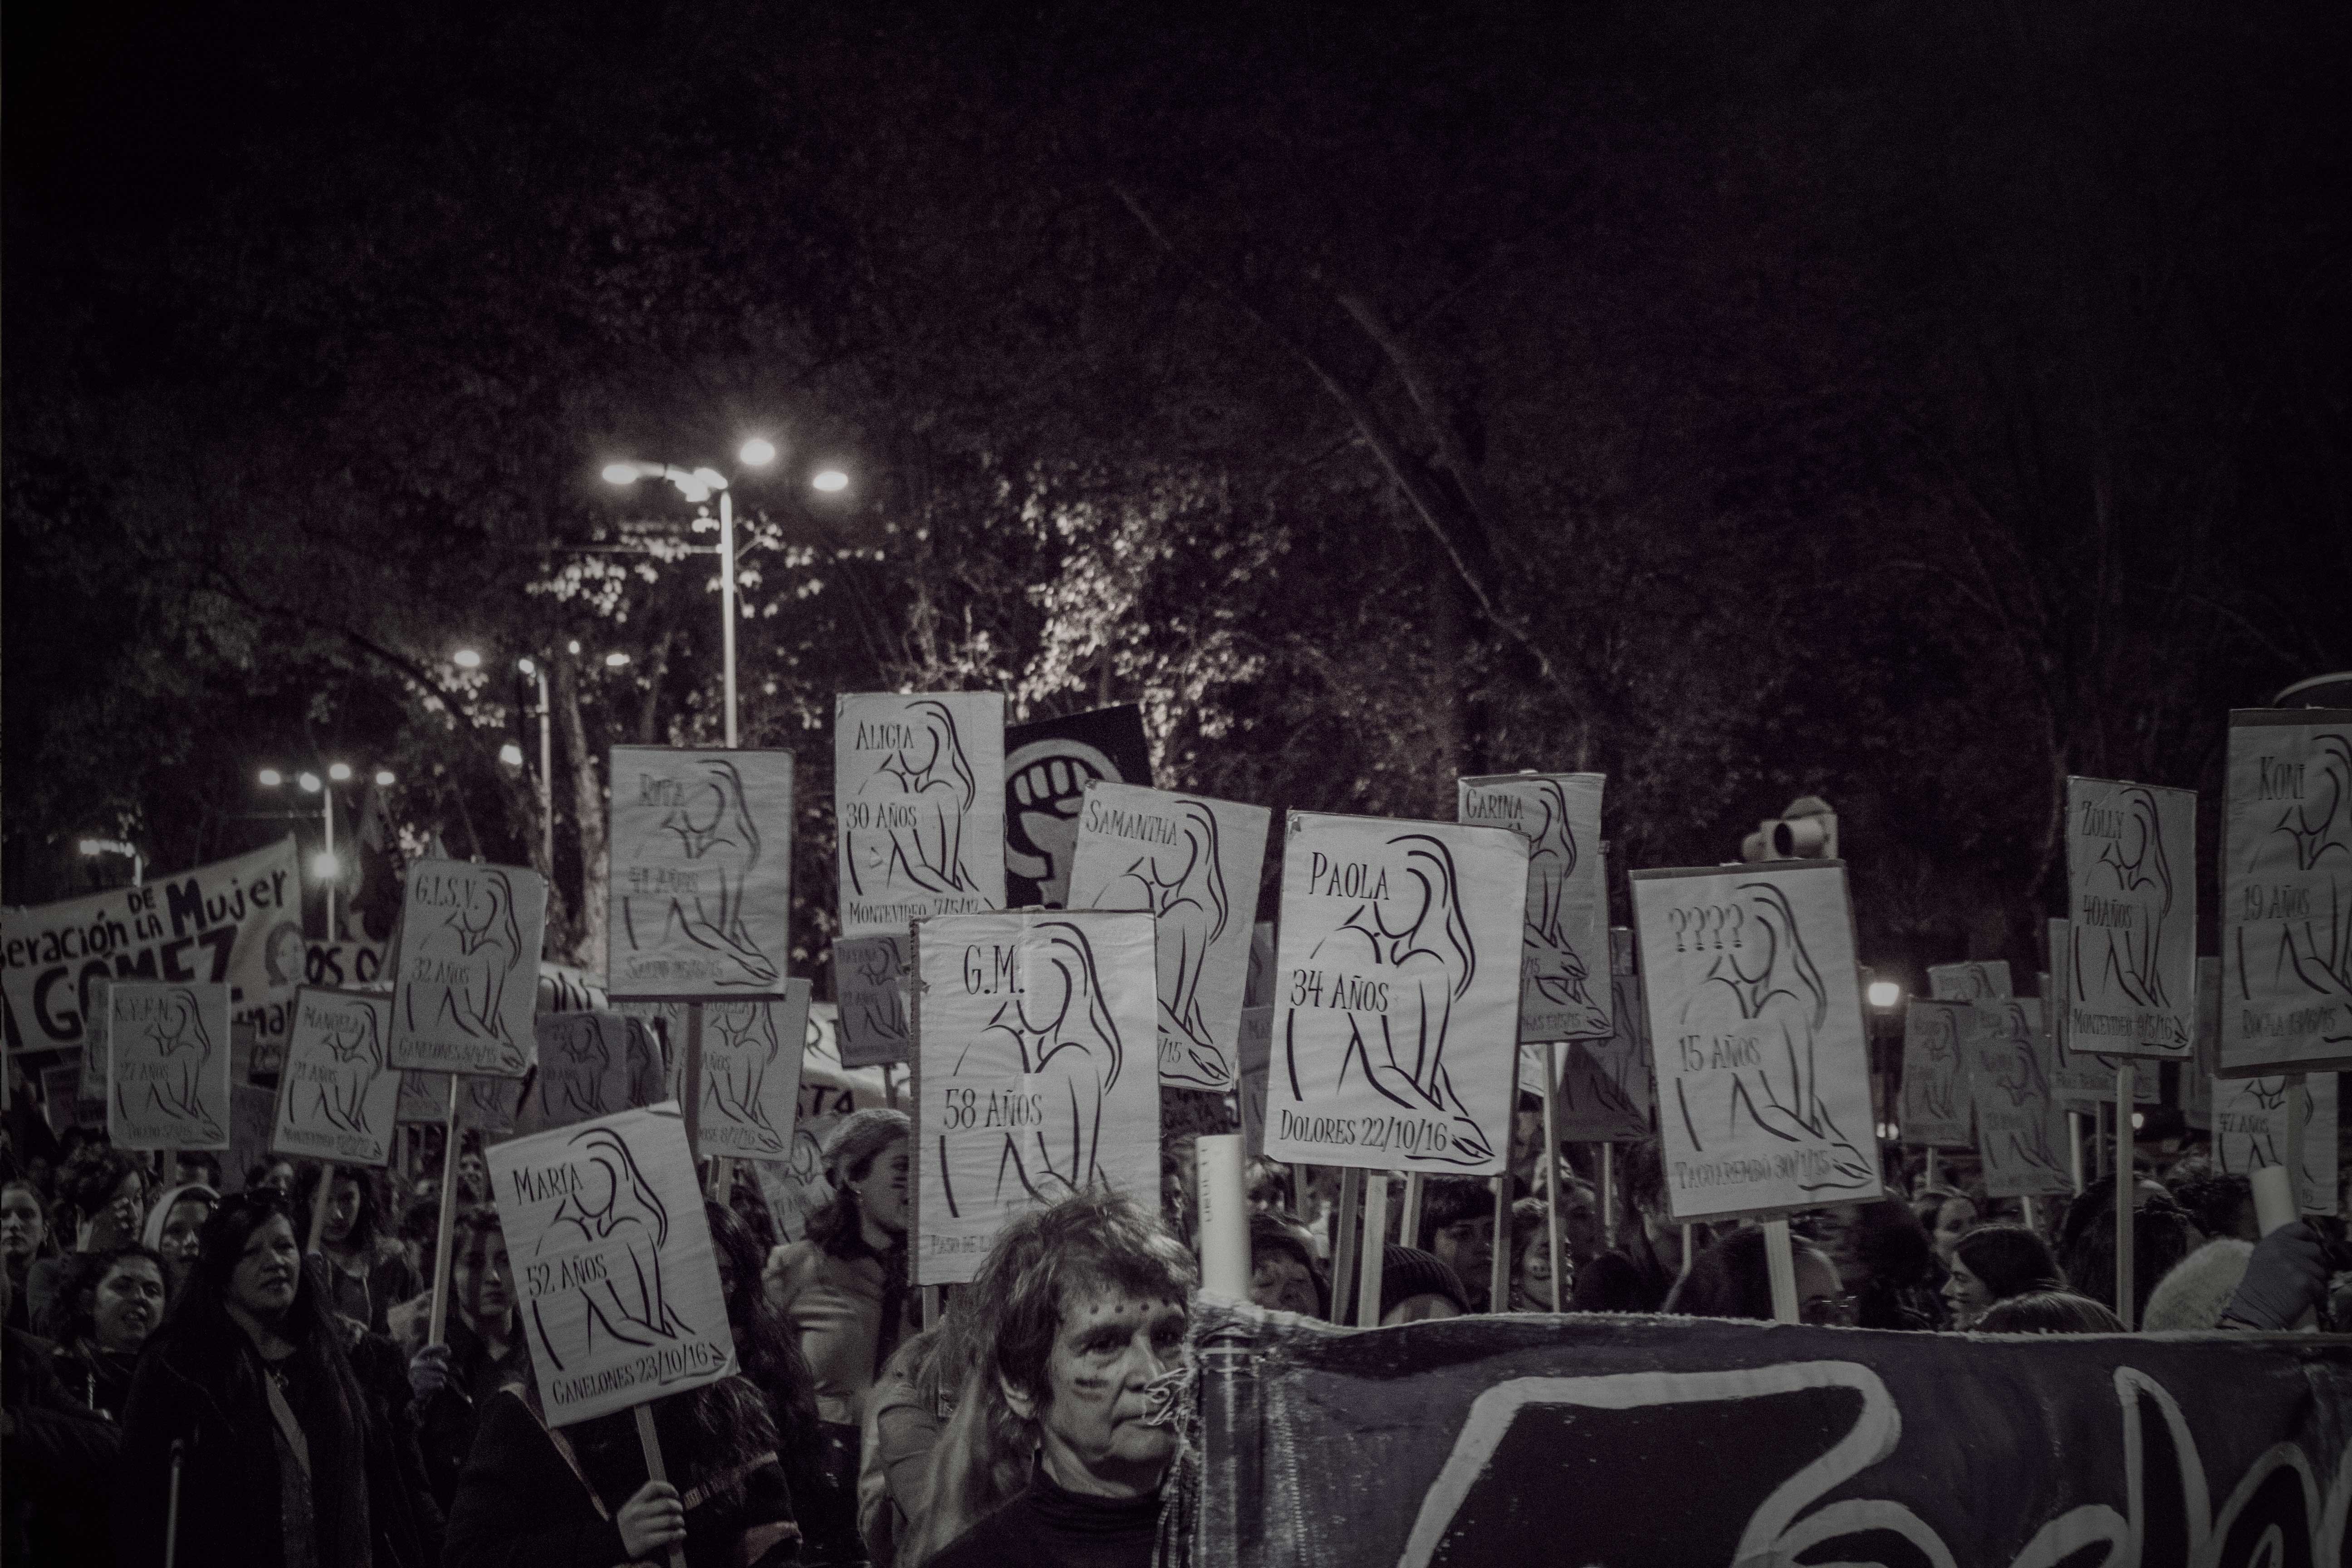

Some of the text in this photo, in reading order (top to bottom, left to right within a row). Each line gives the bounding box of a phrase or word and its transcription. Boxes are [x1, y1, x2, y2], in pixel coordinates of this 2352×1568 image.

[855, 719, 915, 751] ALICIA
[846, 801, 917, 830] 30 AÑOS
[1085, 799, 1178, 846] SAMANTHA
[1465, 789, 1524, 820] CARINA
[1308, 851, 1390, 902] PAOLA
[0, 870, 287, 969] eración DE LA Mujer
[2243, 884, 2310, 921] 19 AÑOS
[1669, 903, 1745, 953] ????
[963, 944, 1025, 995] G.M.
[1290, 969, 1390, 1013] 34 AÑOS
[1679, 1033, 1762, 1073] 15 AÑOS
[943, 1088, 1044, 1130] 58 AÑOS
[1279, 1108, 1448, 1153] DOLORES 22/10/16
[513, 1162, 584, 1205] MARÍA
[526, 1253, 608, 1299] 52 AÑOS
[552, 1341, 710, 1405] CANELONES 23/10/16
